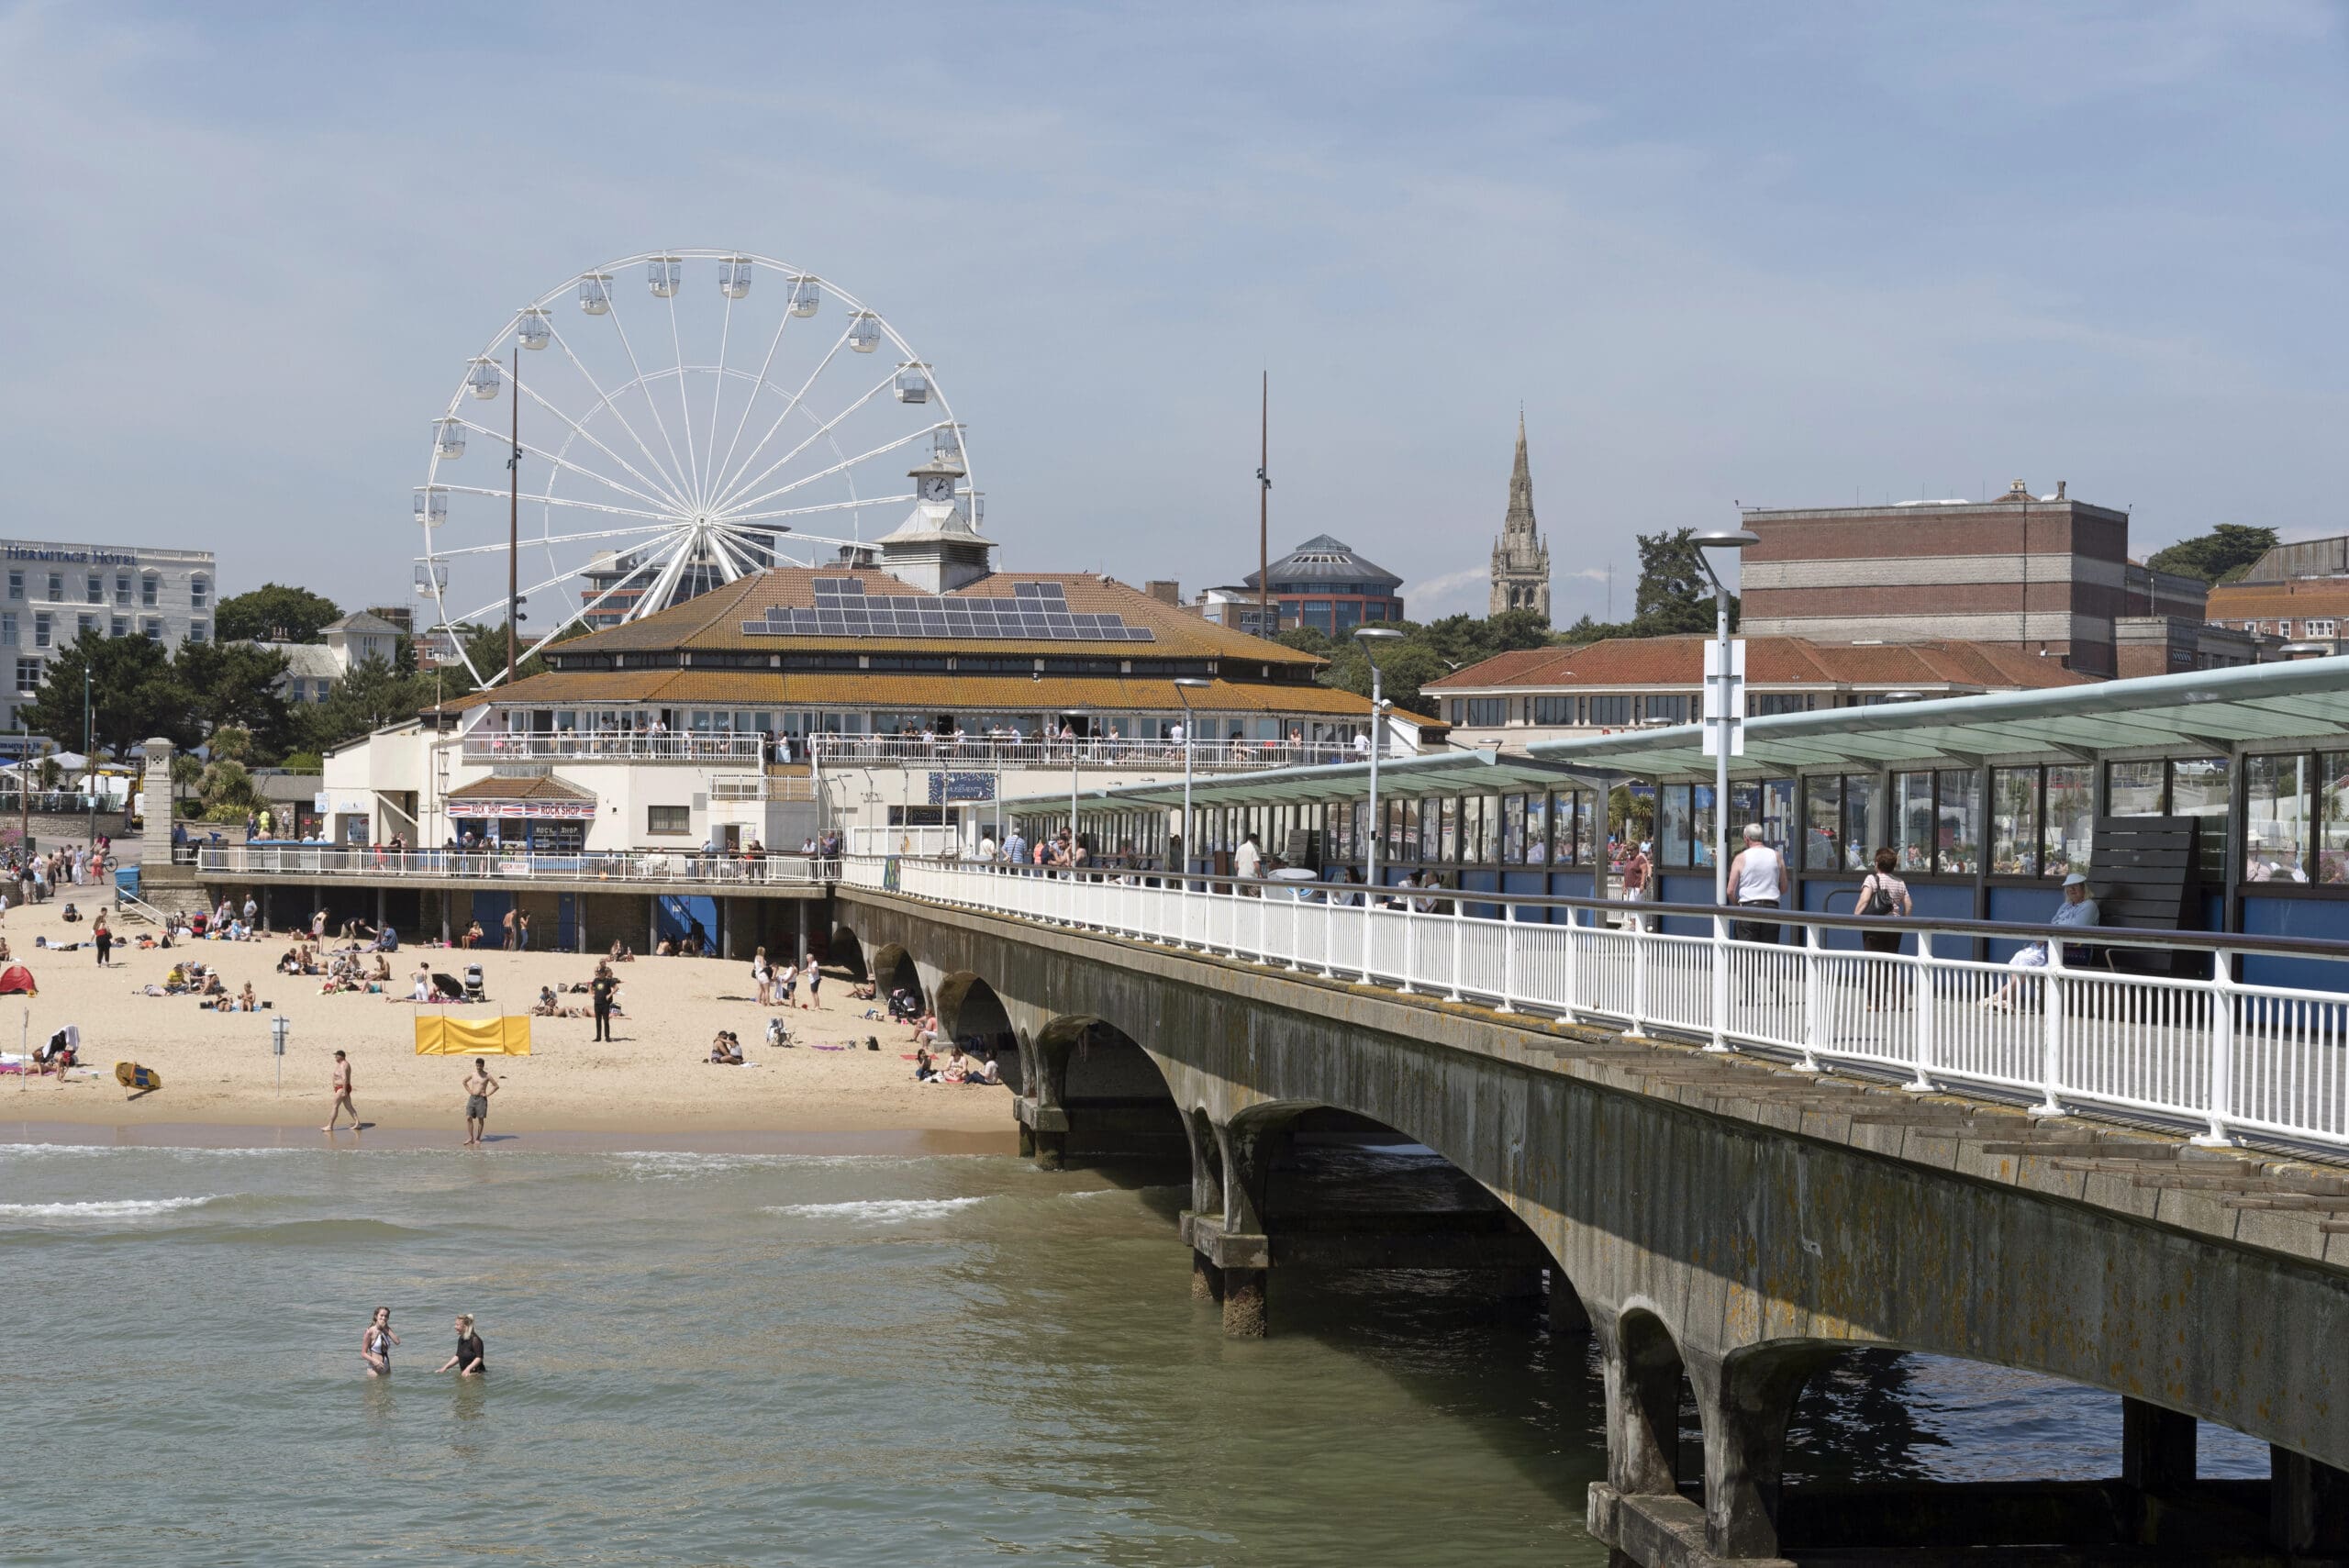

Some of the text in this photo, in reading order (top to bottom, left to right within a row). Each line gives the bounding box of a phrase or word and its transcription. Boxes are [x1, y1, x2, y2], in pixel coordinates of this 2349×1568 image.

[6, 545, 138, 565] HERMITAGE HOTEL
[472, 805, 501, 814] ROCK SHOP
[540, 806, 580, 815] ROCK SHOP
[561, 827, 578, 835] SHOP
